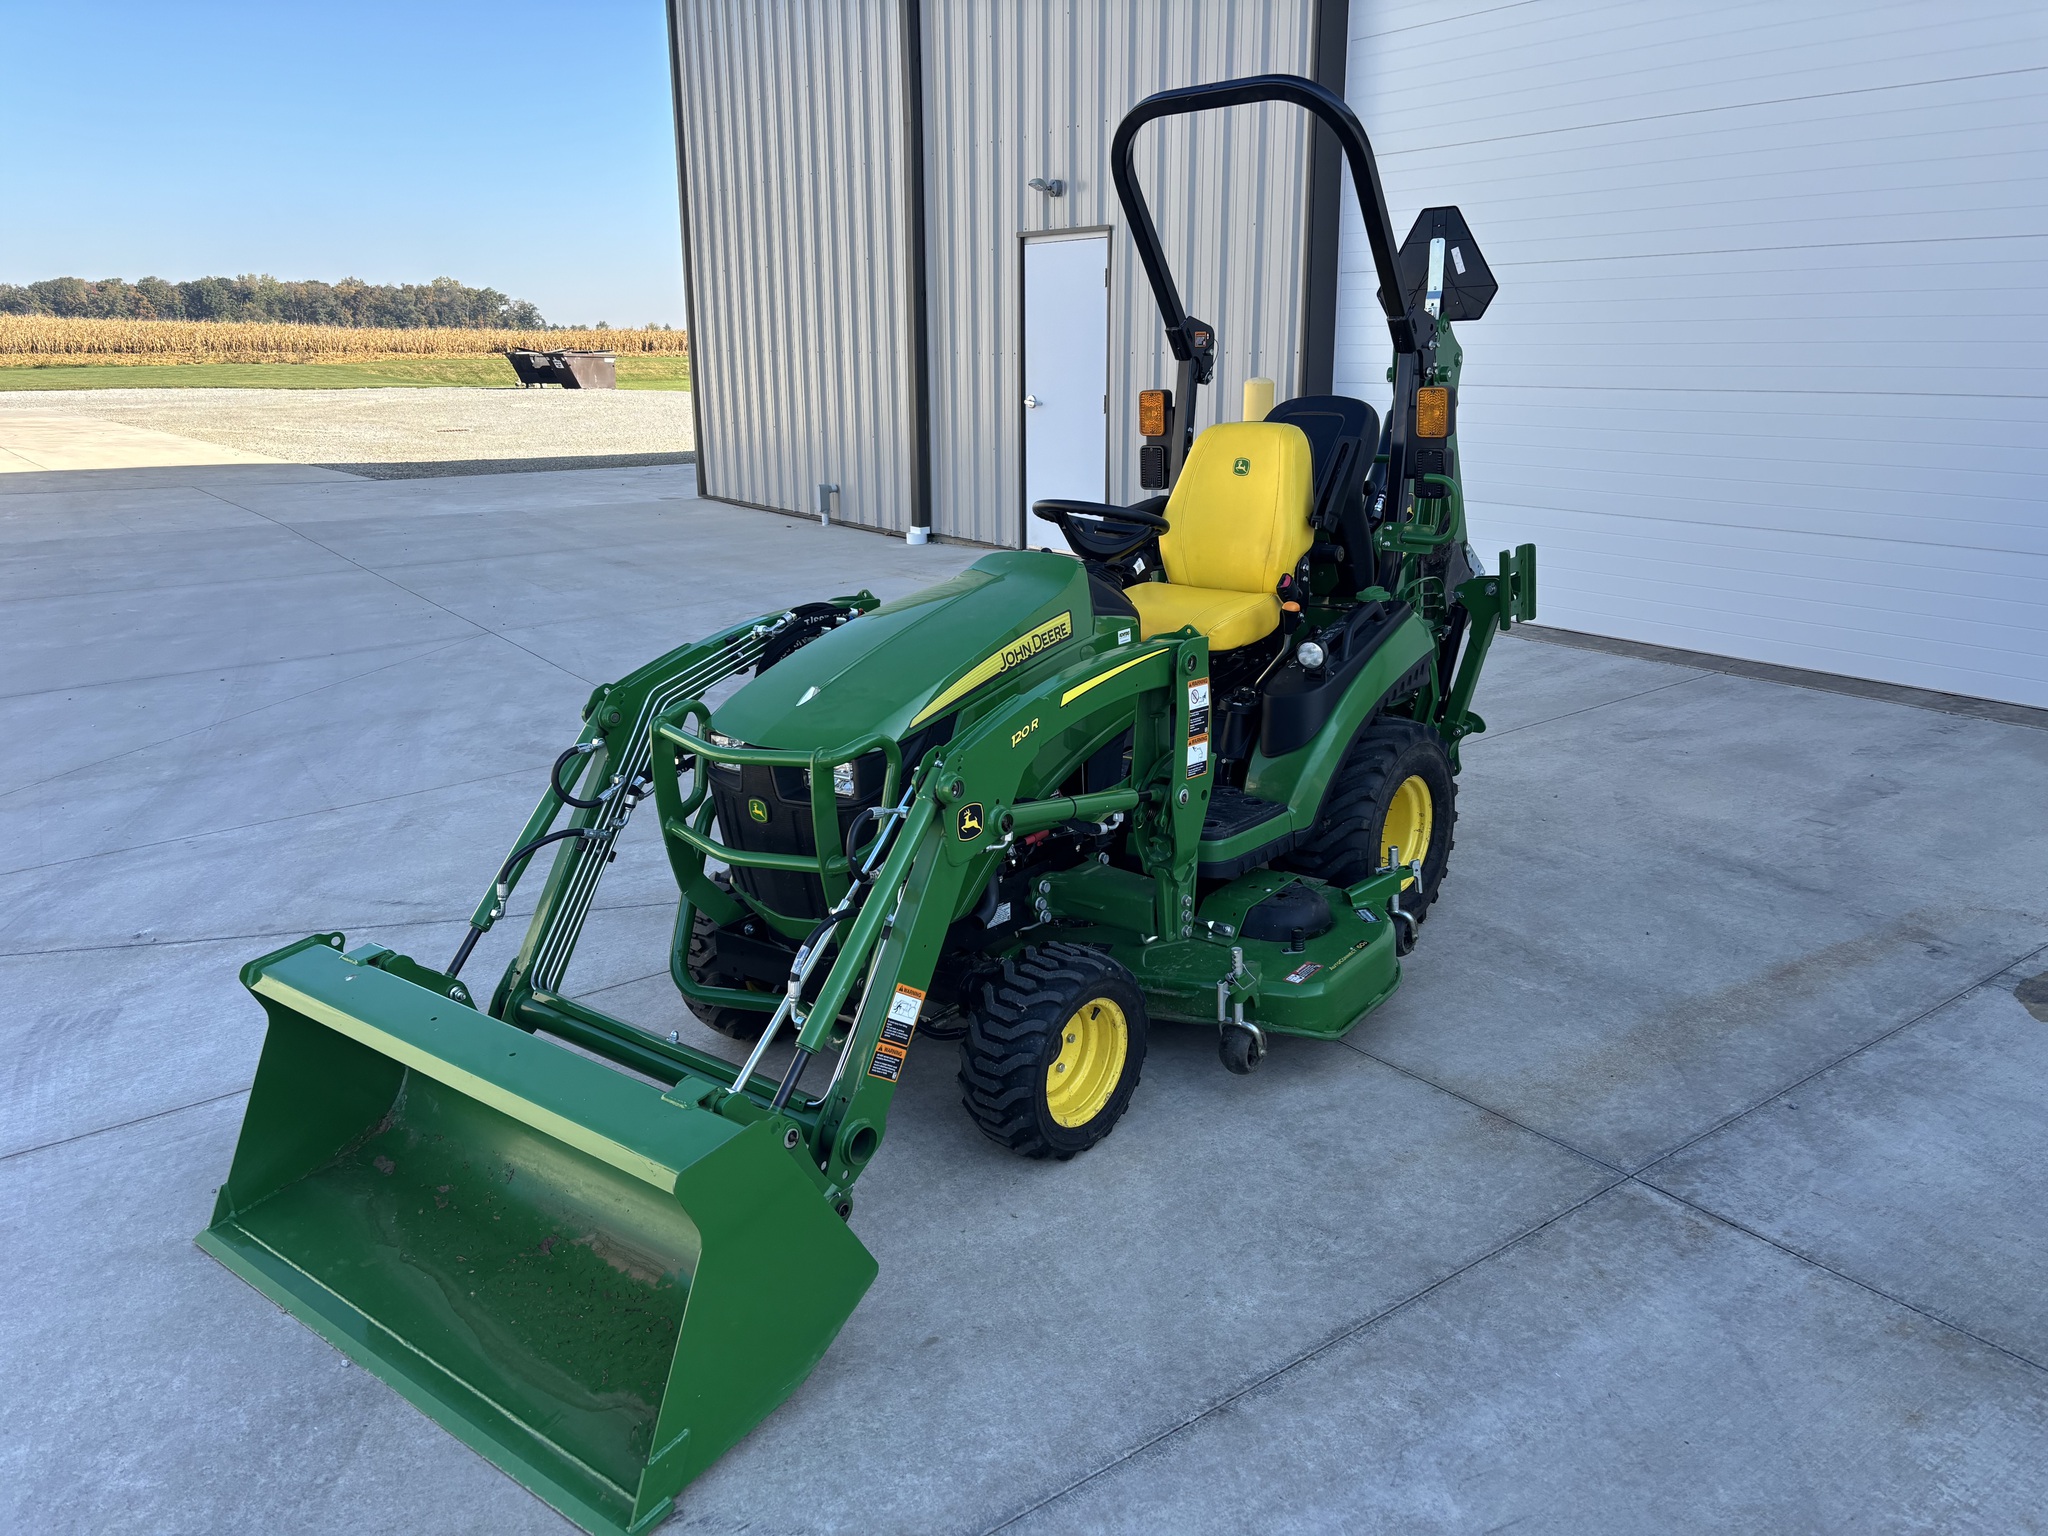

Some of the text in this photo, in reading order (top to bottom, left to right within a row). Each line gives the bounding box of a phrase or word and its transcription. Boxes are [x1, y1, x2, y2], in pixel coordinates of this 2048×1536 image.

[1000, 623, 1069, 670] JOHN DEERE
[1011, 717, 1039, 748] 120 R
[903, 988, 922, 998] WARNING
[884, 1046, 903, 1057] WARNING
